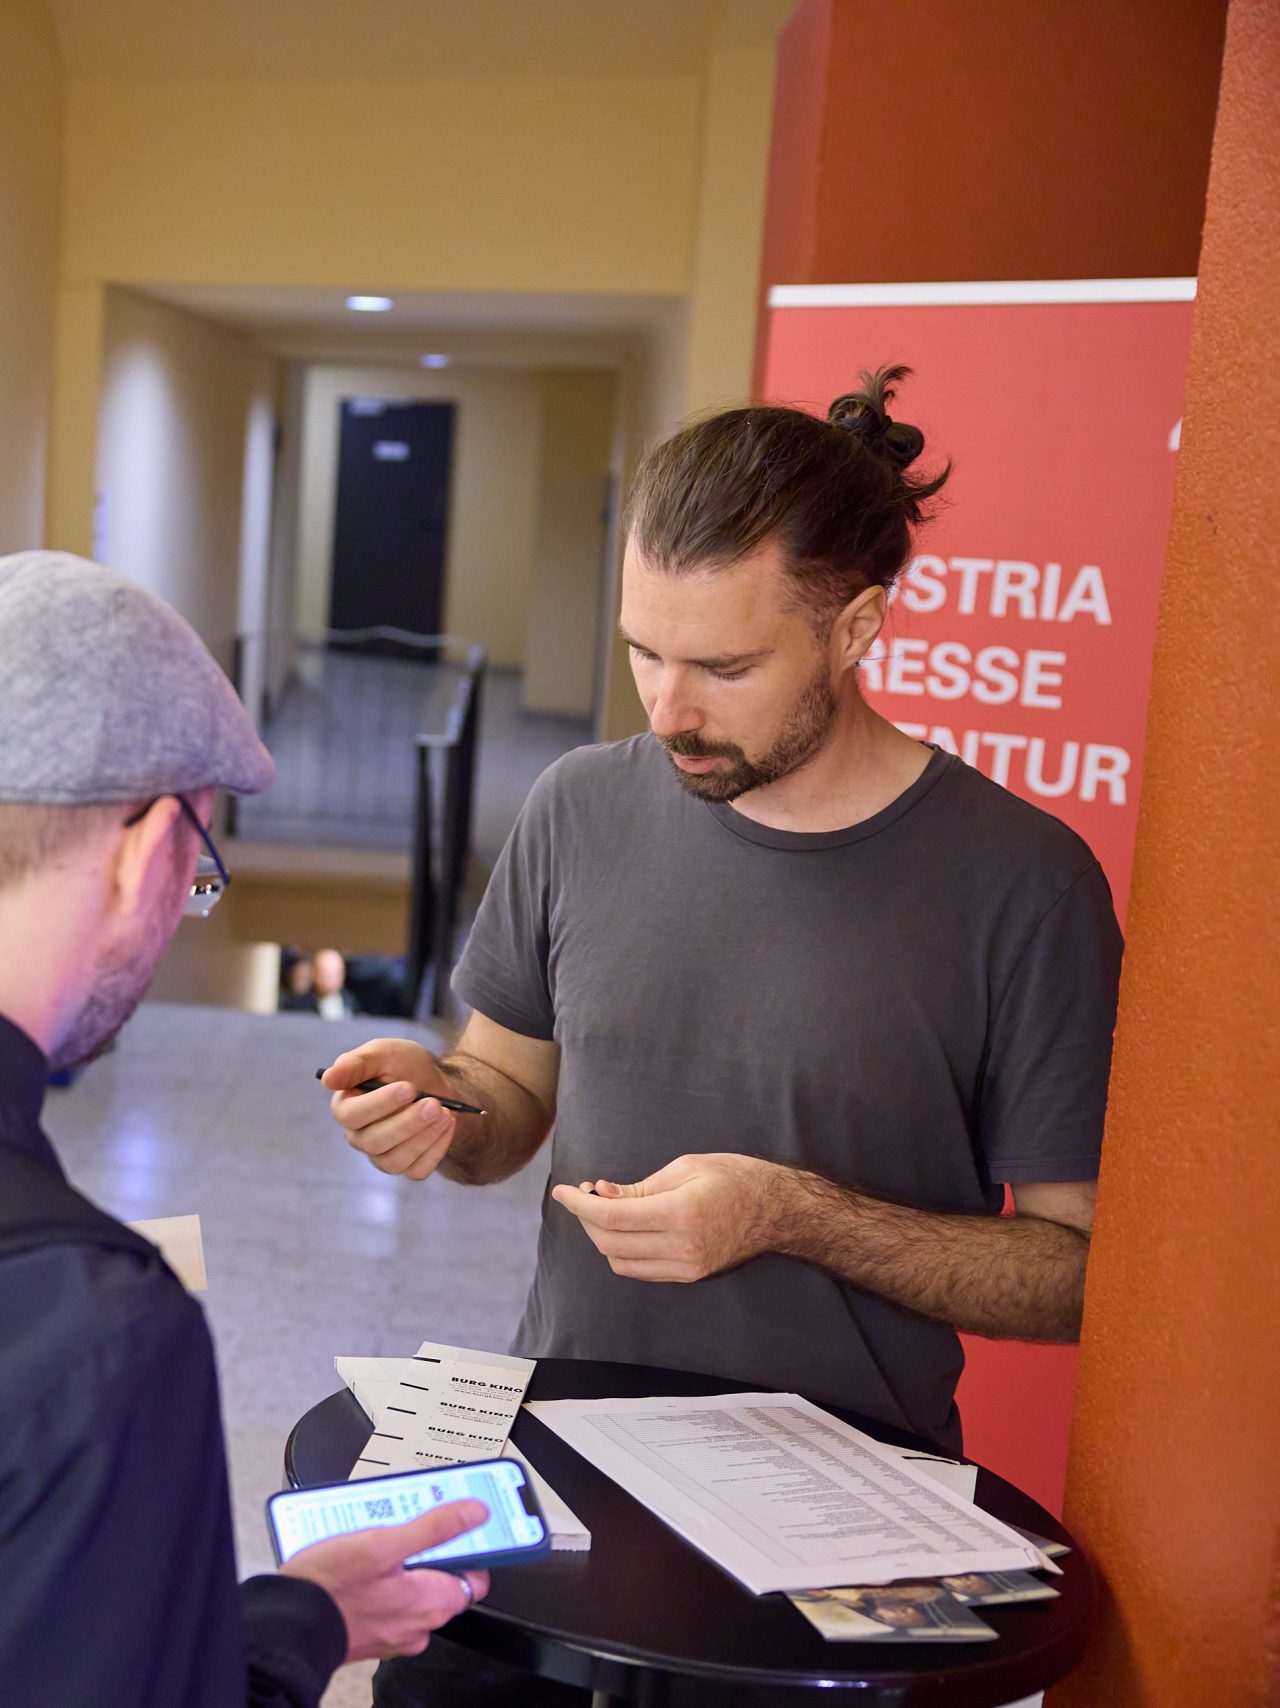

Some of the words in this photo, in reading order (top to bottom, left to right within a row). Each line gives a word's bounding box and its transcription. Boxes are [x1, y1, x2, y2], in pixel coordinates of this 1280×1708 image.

[886, 553, 1112, 625] STRIA
[858, 637, 1066, 709] RESSE
[451, 1376, 487, 1387] BURG
[489, 1383, 523, 1393] KINO
[439, 1401, 476, 1411] BURG
[479, 1409, 514, 1418] KINO
[428, 1426, 465, 1437] BURG
[468, 1434, 504, 1443] KINO
